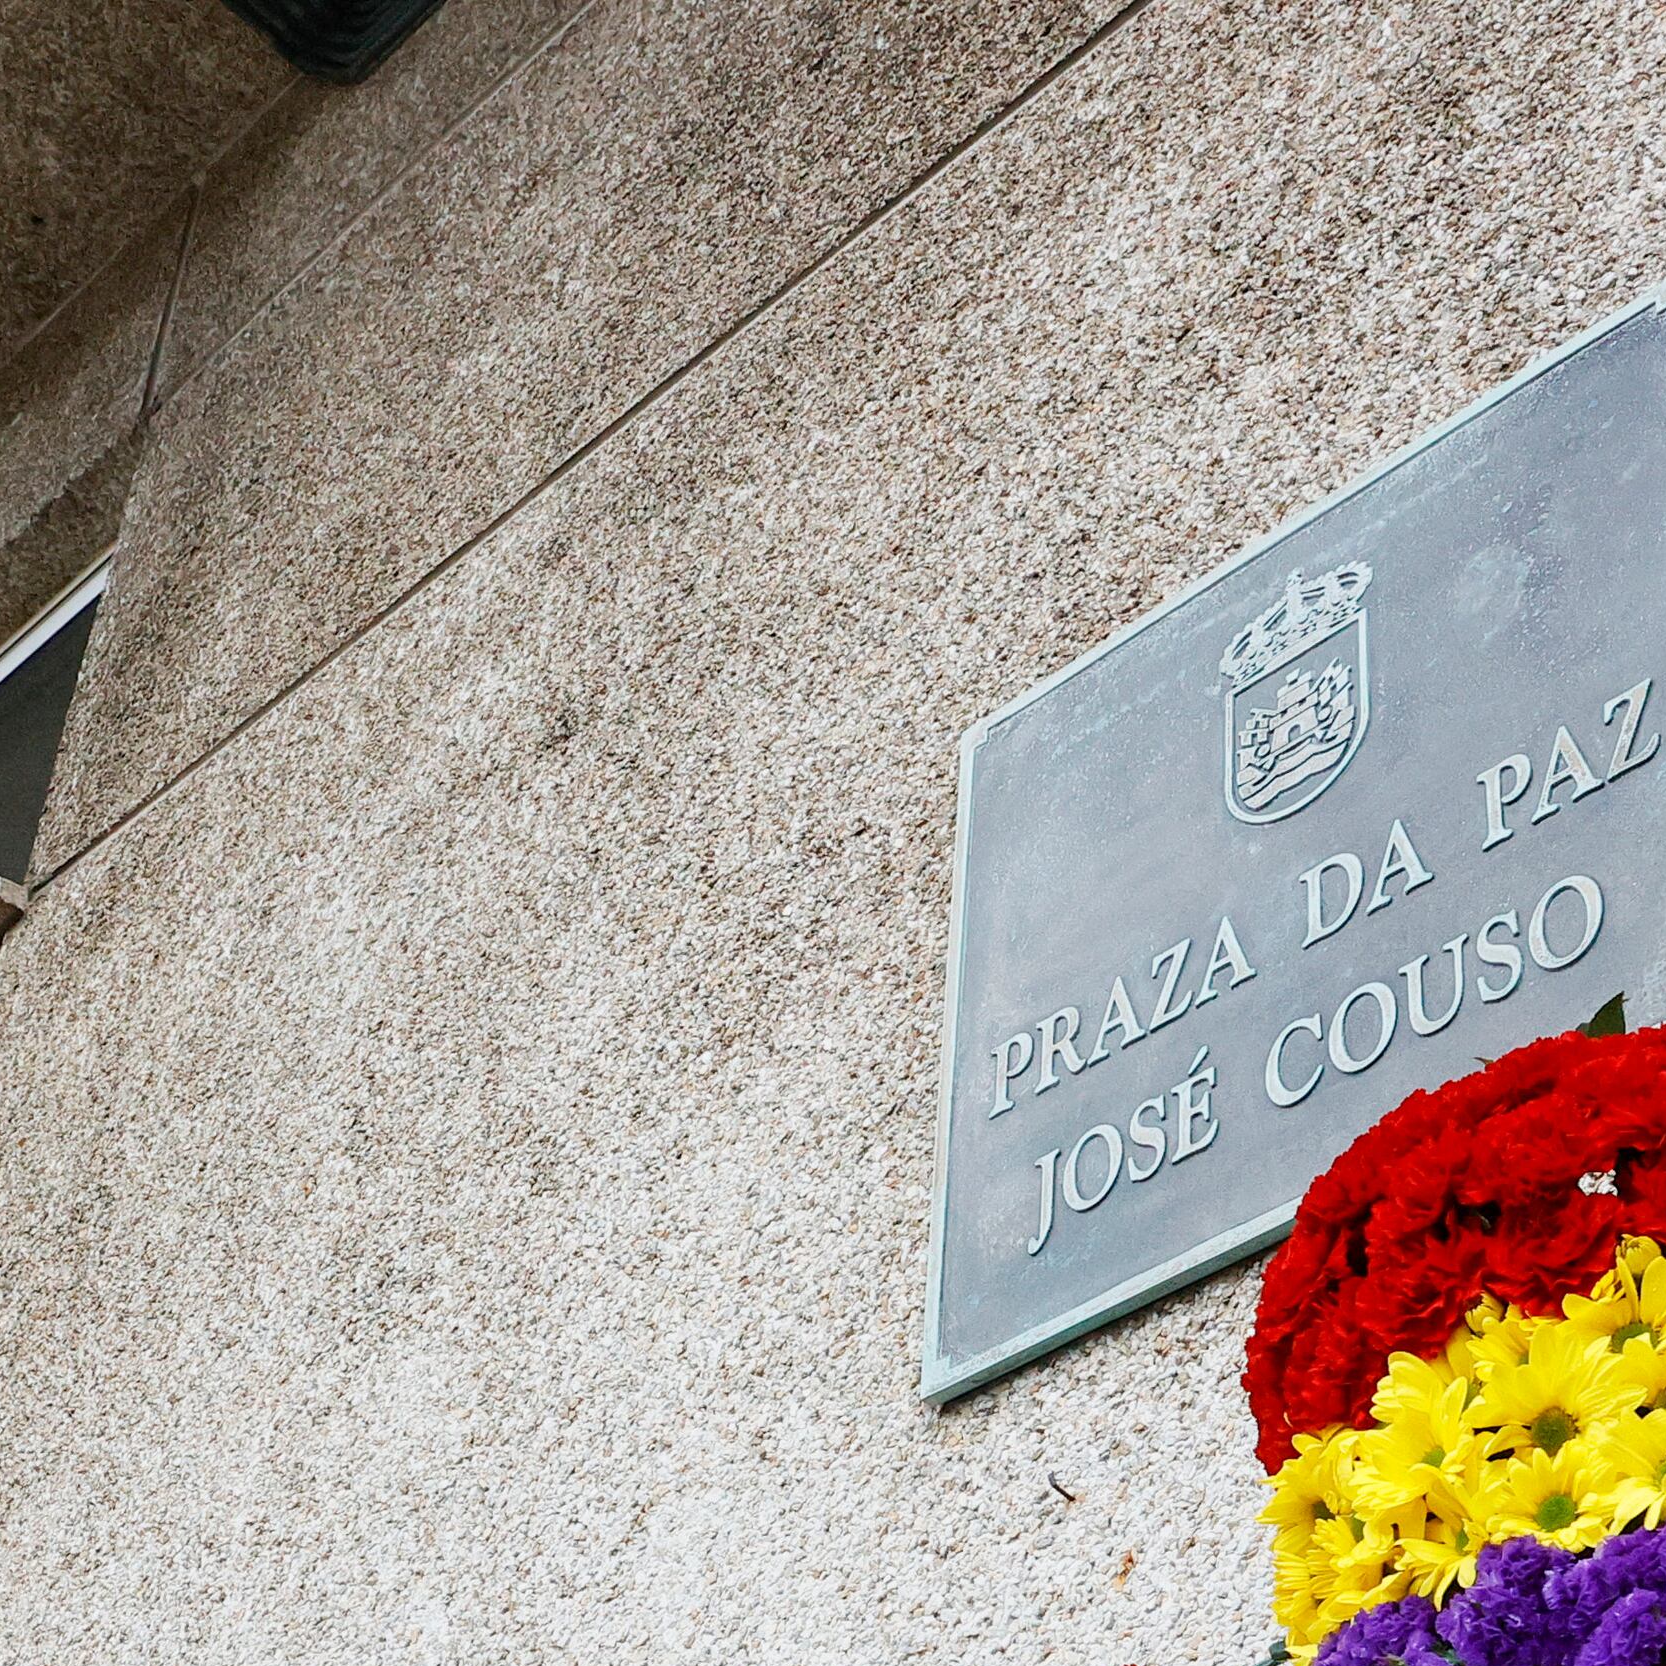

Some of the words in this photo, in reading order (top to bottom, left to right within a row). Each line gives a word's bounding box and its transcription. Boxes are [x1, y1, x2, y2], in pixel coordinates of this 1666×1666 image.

[988, 915, 1257, 1119] PRAZA
[1299, 819, 1434, 949] DA
[1476, 678, 1661, 852] PAZ
[1027, 1045, 1220, 1256] JOSÉ
[1264, 875, 1606, 1108] COUSO
